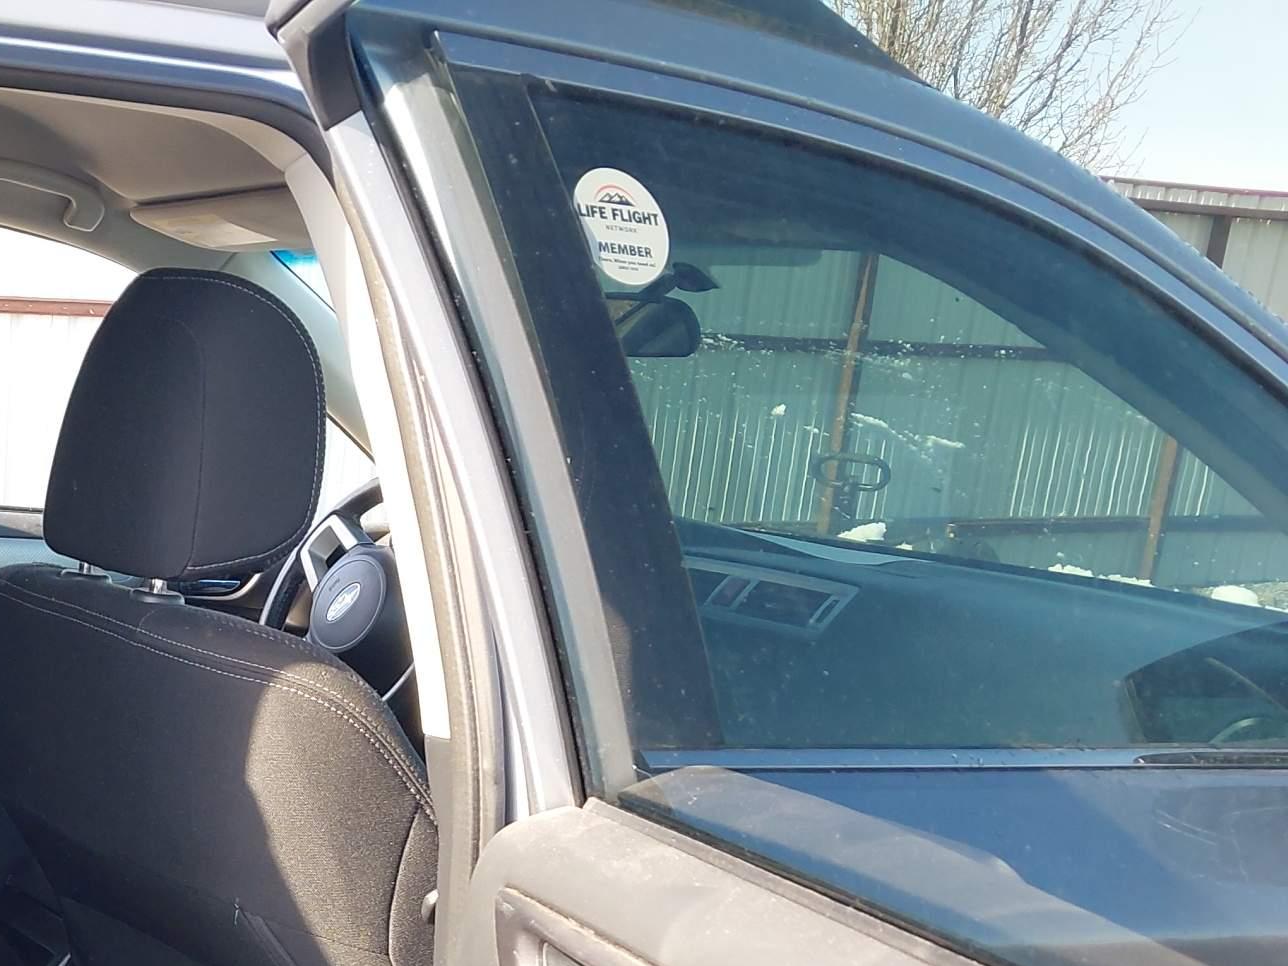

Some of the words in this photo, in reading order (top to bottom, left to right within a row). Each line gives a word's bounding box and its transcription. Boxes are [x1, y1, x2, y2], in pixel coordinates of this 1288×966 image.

[577, 203, 608, 220] LIFE
[611, 208, 659, 226] FLIGHT
[598, 241, 653, 258] MEMBER
